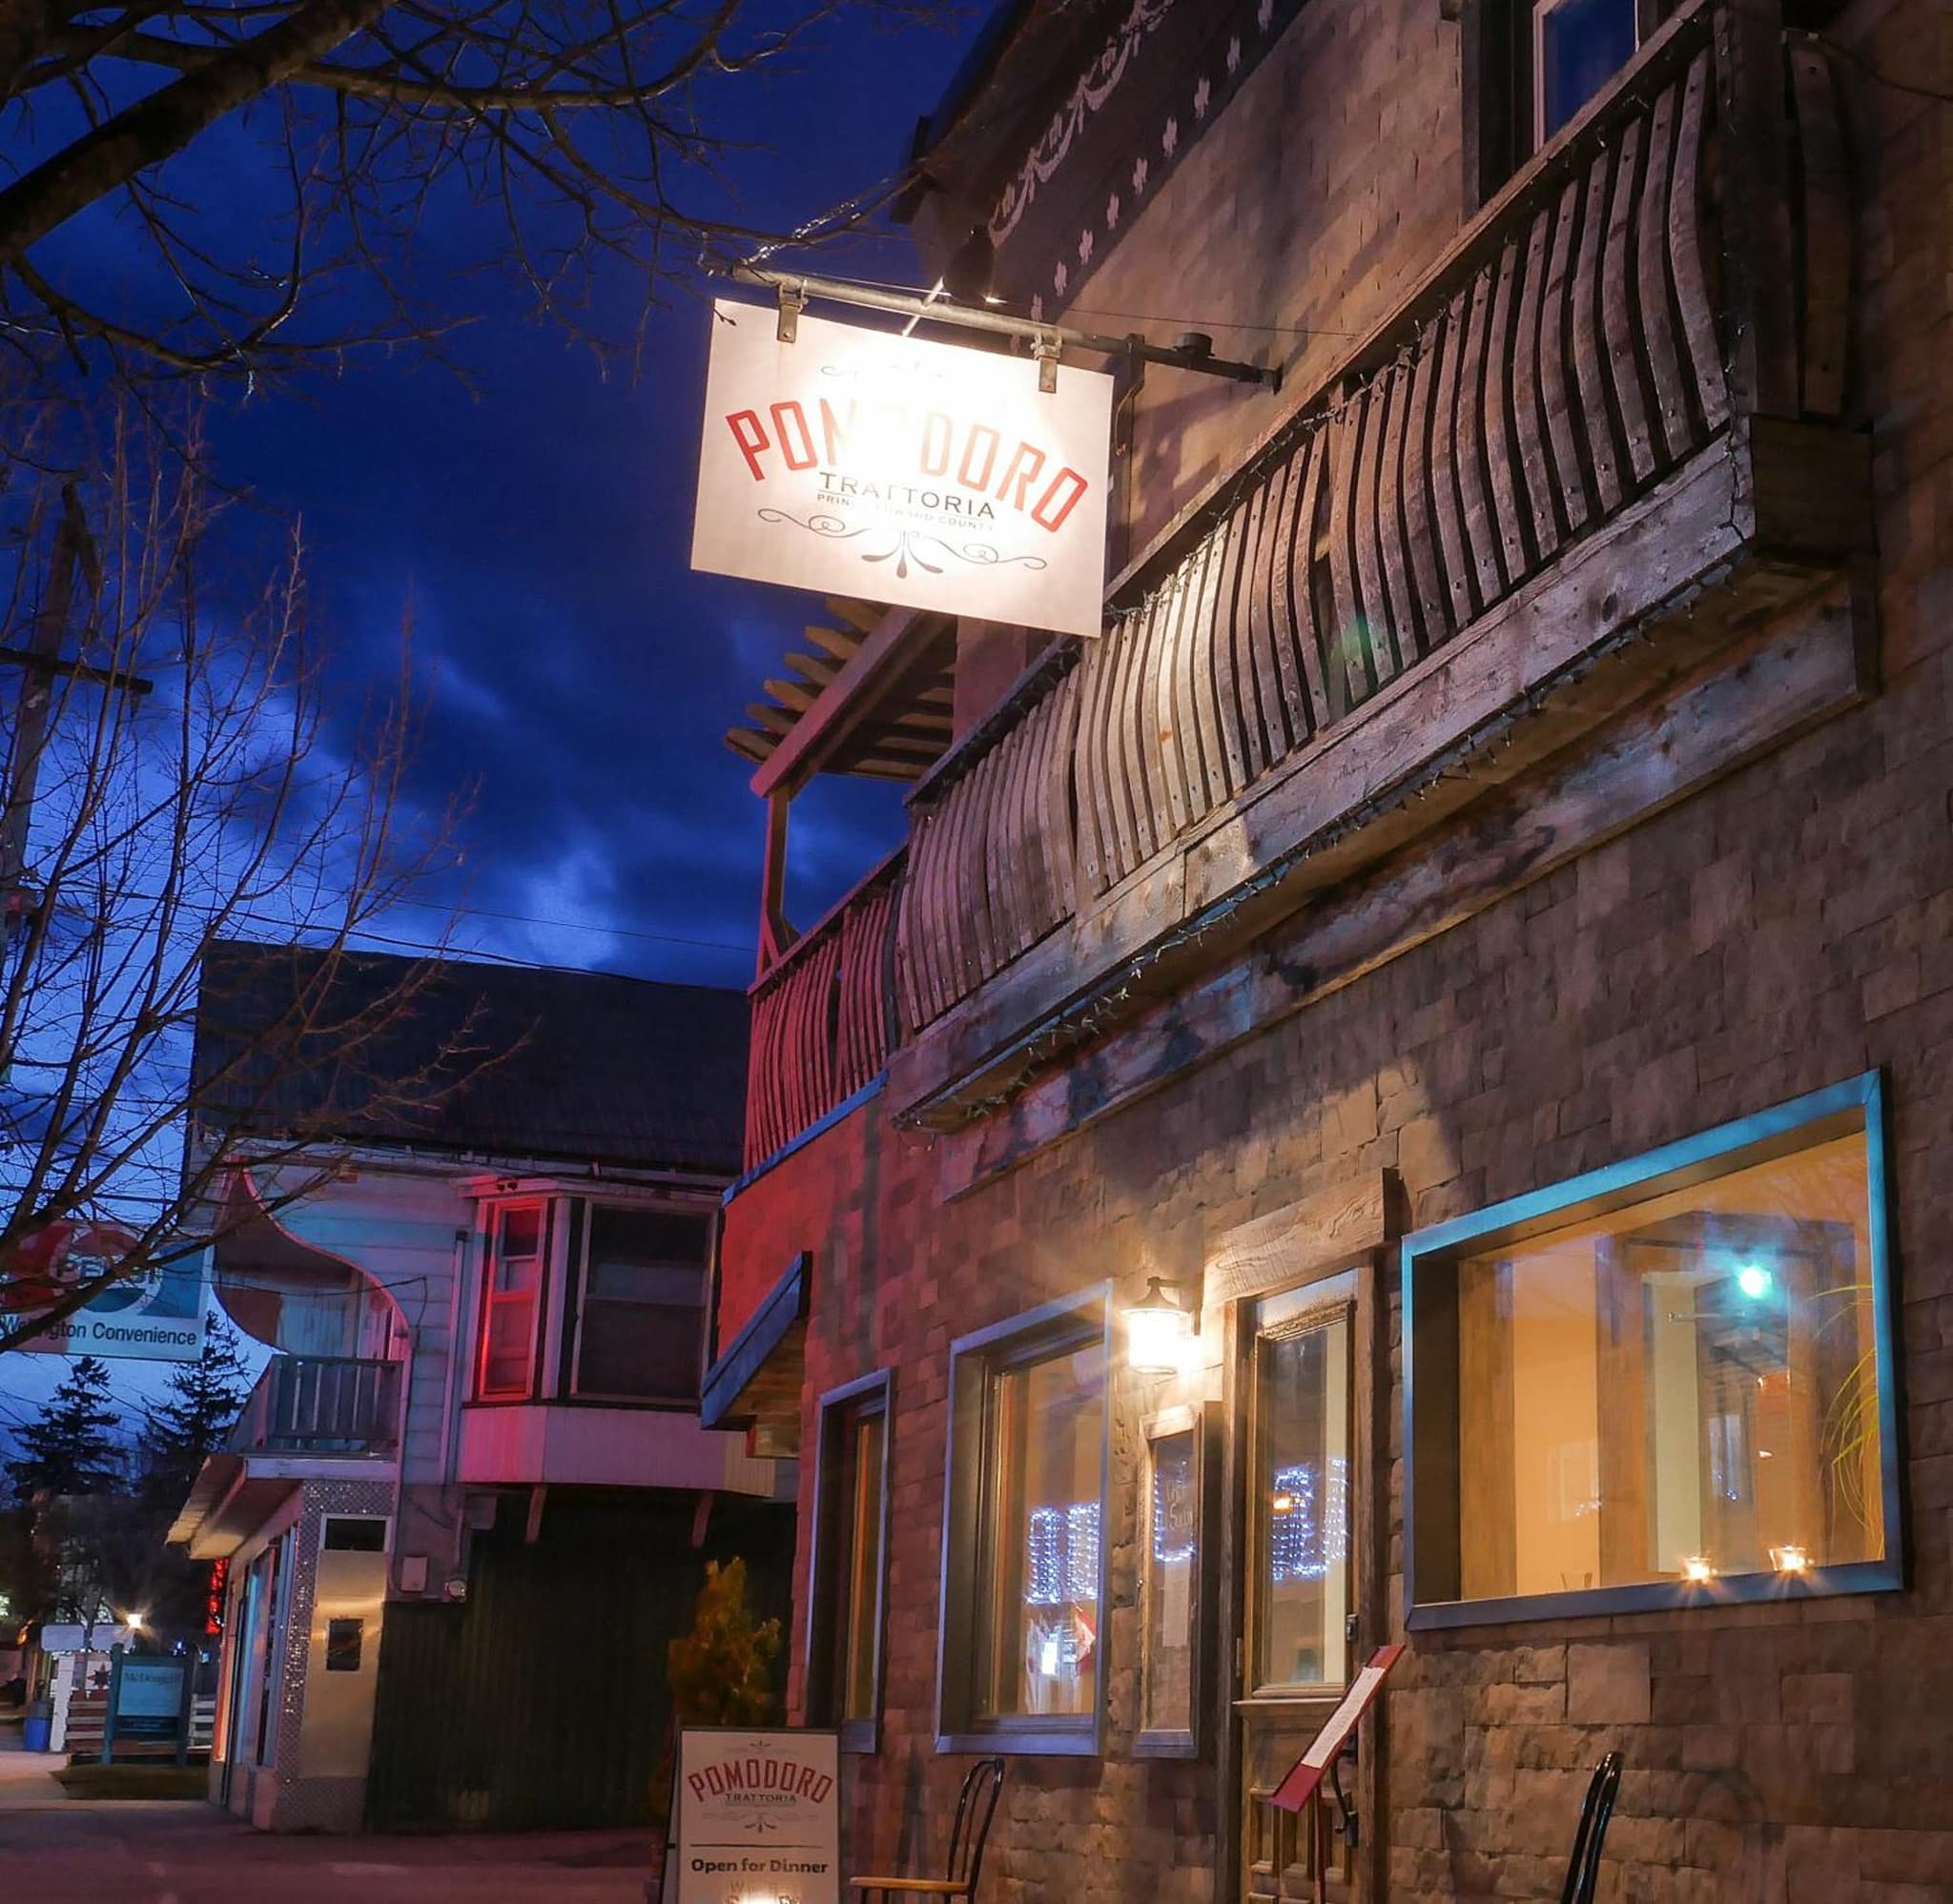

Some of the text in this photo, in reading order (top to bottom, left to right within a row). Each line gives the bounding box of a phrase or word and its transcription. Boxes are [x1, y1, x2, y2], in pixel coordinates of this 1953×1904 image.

[725, 398, 1089, 533] POMDORO
[817, 494, 861, 508] PRIN
[818, 471, 995, 520] TRATTORIA
[93, 1322, 197, 1345] Convenience
[688, 1758, 833, 1803] POMODORO
[724, 1792, 796, 1802] TRATTORIA
[691, 1858, 828, 1873] Open for Dinner
